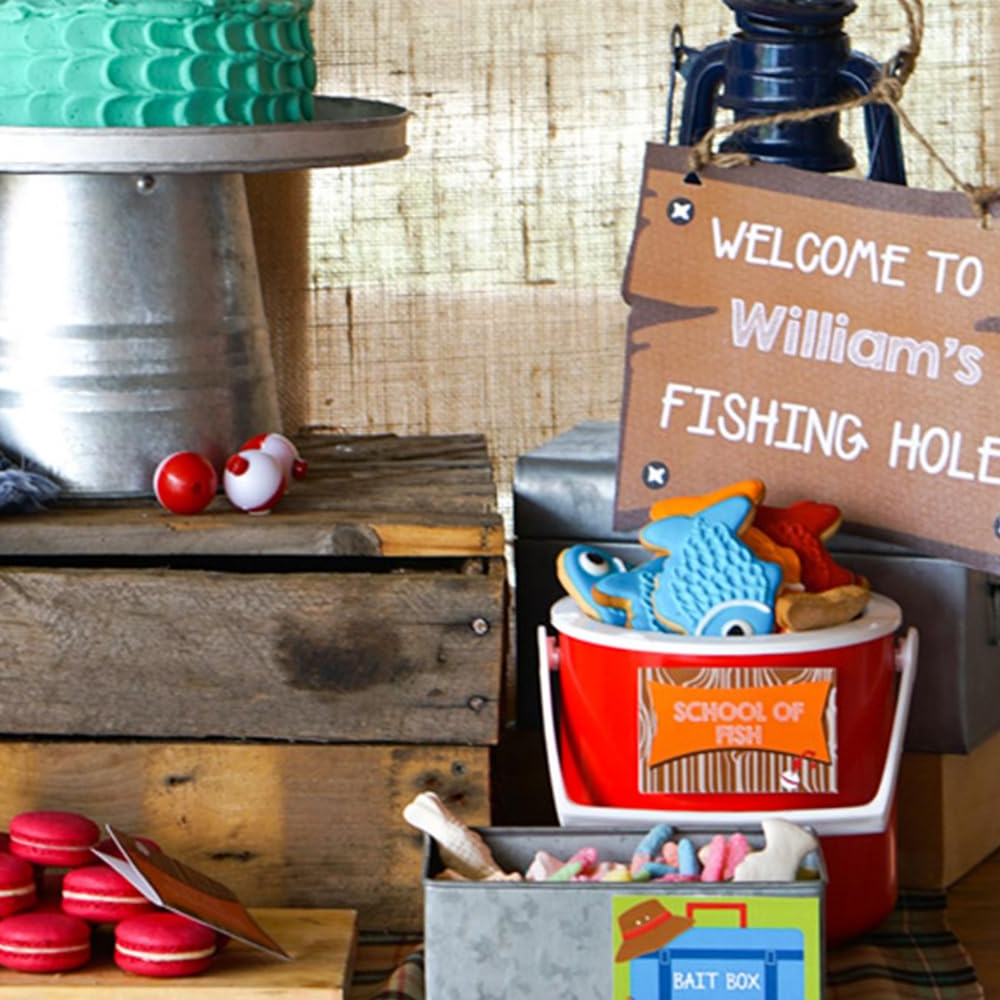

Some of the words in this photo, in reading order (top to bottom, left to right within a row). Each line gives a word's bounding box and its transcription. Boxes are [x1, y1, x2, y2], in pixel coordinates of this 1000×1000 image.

[711, 217, 910, 287] WELCOME
[926, 250, 983, 297] TO
[659, 383, 869, 460] FISHING
[888, 421, 1000, 485] HOLE
[673, 701, 767, 723] SCHOOL
[772, 702, 806, 722] OF
[715, 725, 763, 745] FISH
[672, 971, 719, 990] BAIT
[725, 972, 762, 990] BOX
